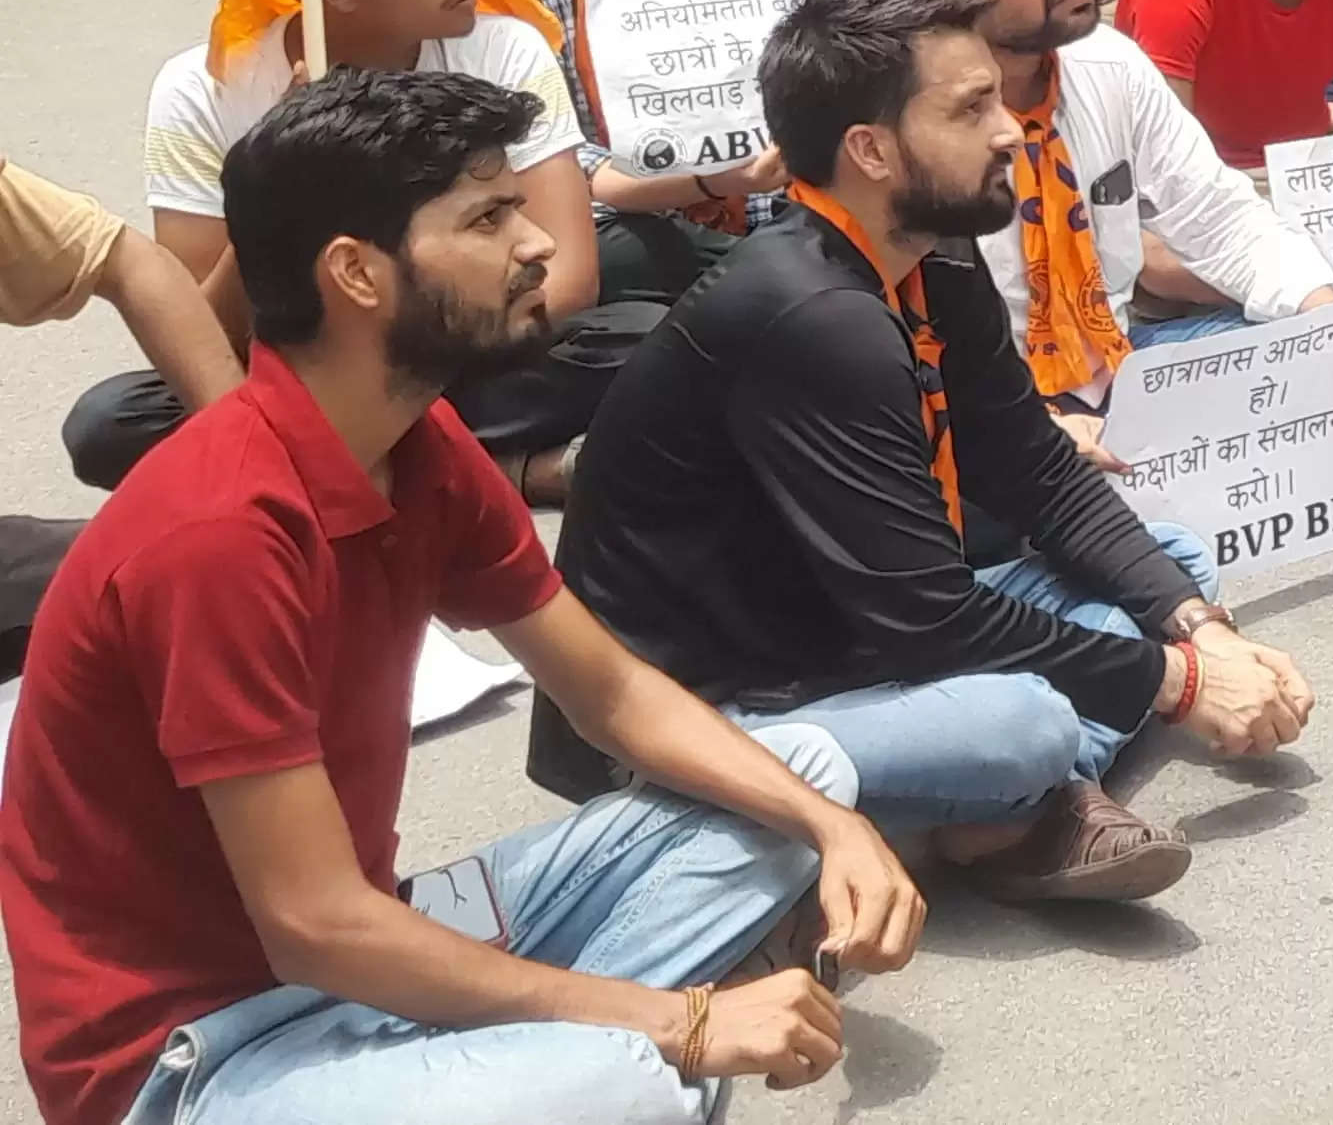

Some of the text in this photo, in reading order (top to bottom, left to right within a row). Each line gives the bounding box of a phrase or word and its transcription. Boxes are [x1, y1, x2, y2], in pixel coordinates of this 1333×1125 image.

[647, 32, 754, 77] छात्रों के
[627, 78, 746, 119] खिलवाड़
[1142, 345, 1259, 394] छात्रावास
[1121, 435, 1210, 492] कक्षाओं
[1216, 432, 1250, 463] का
[1214, 512, 1294, 567] BVP
